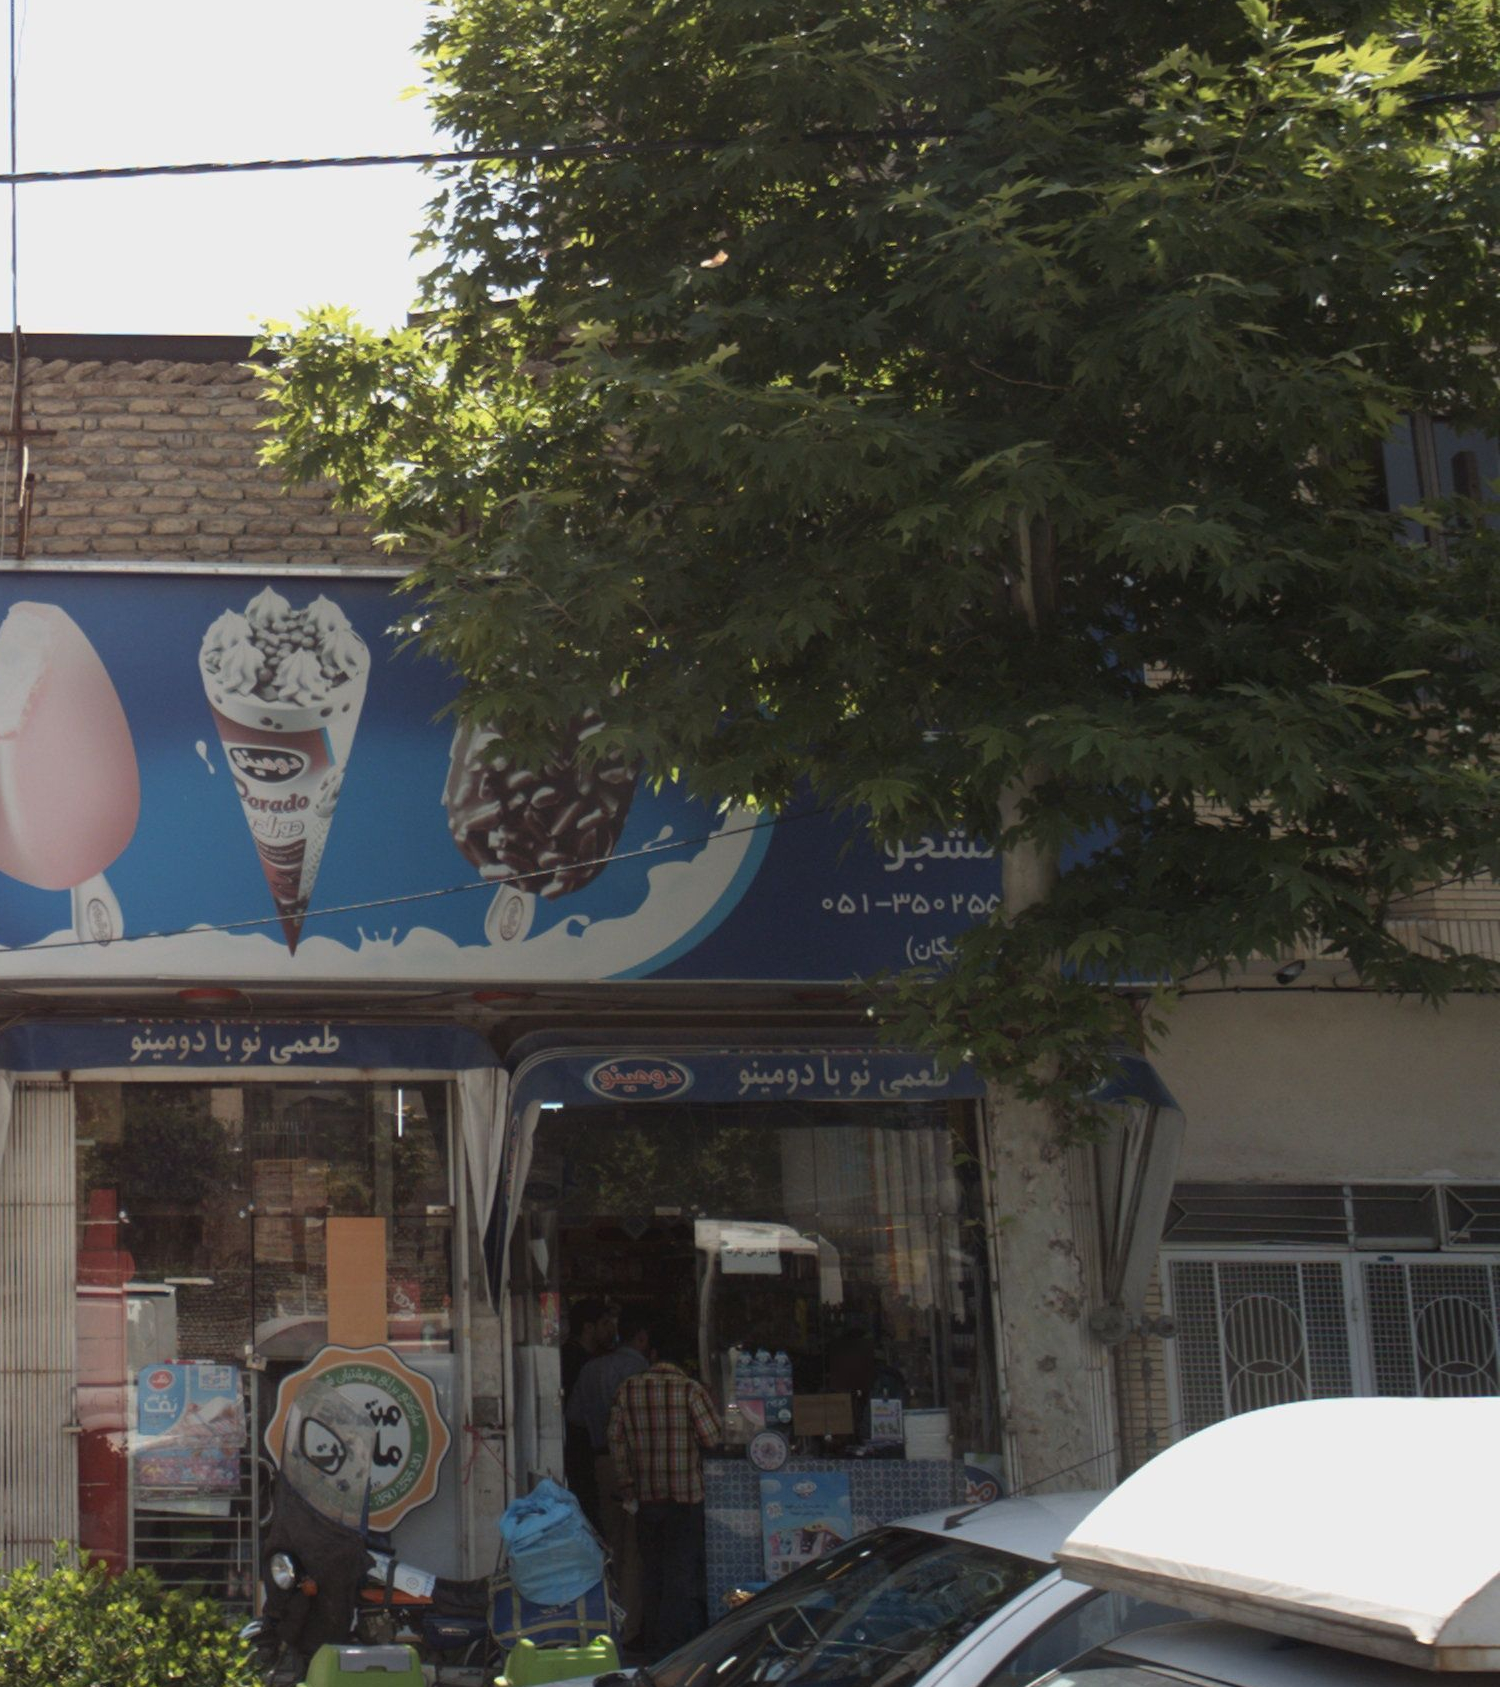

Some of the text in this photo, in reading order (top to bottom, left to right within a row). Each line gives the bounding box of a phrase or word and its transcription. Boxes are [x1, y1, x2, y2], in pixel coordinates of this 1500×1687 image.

[129, 1023, 341, 1065] طعمی نو با دومینو
[737, 1060, 816, 1096] دومینو
[822, 1055, 841, 1097] با
[850, 1058, 872, 1097] نو
